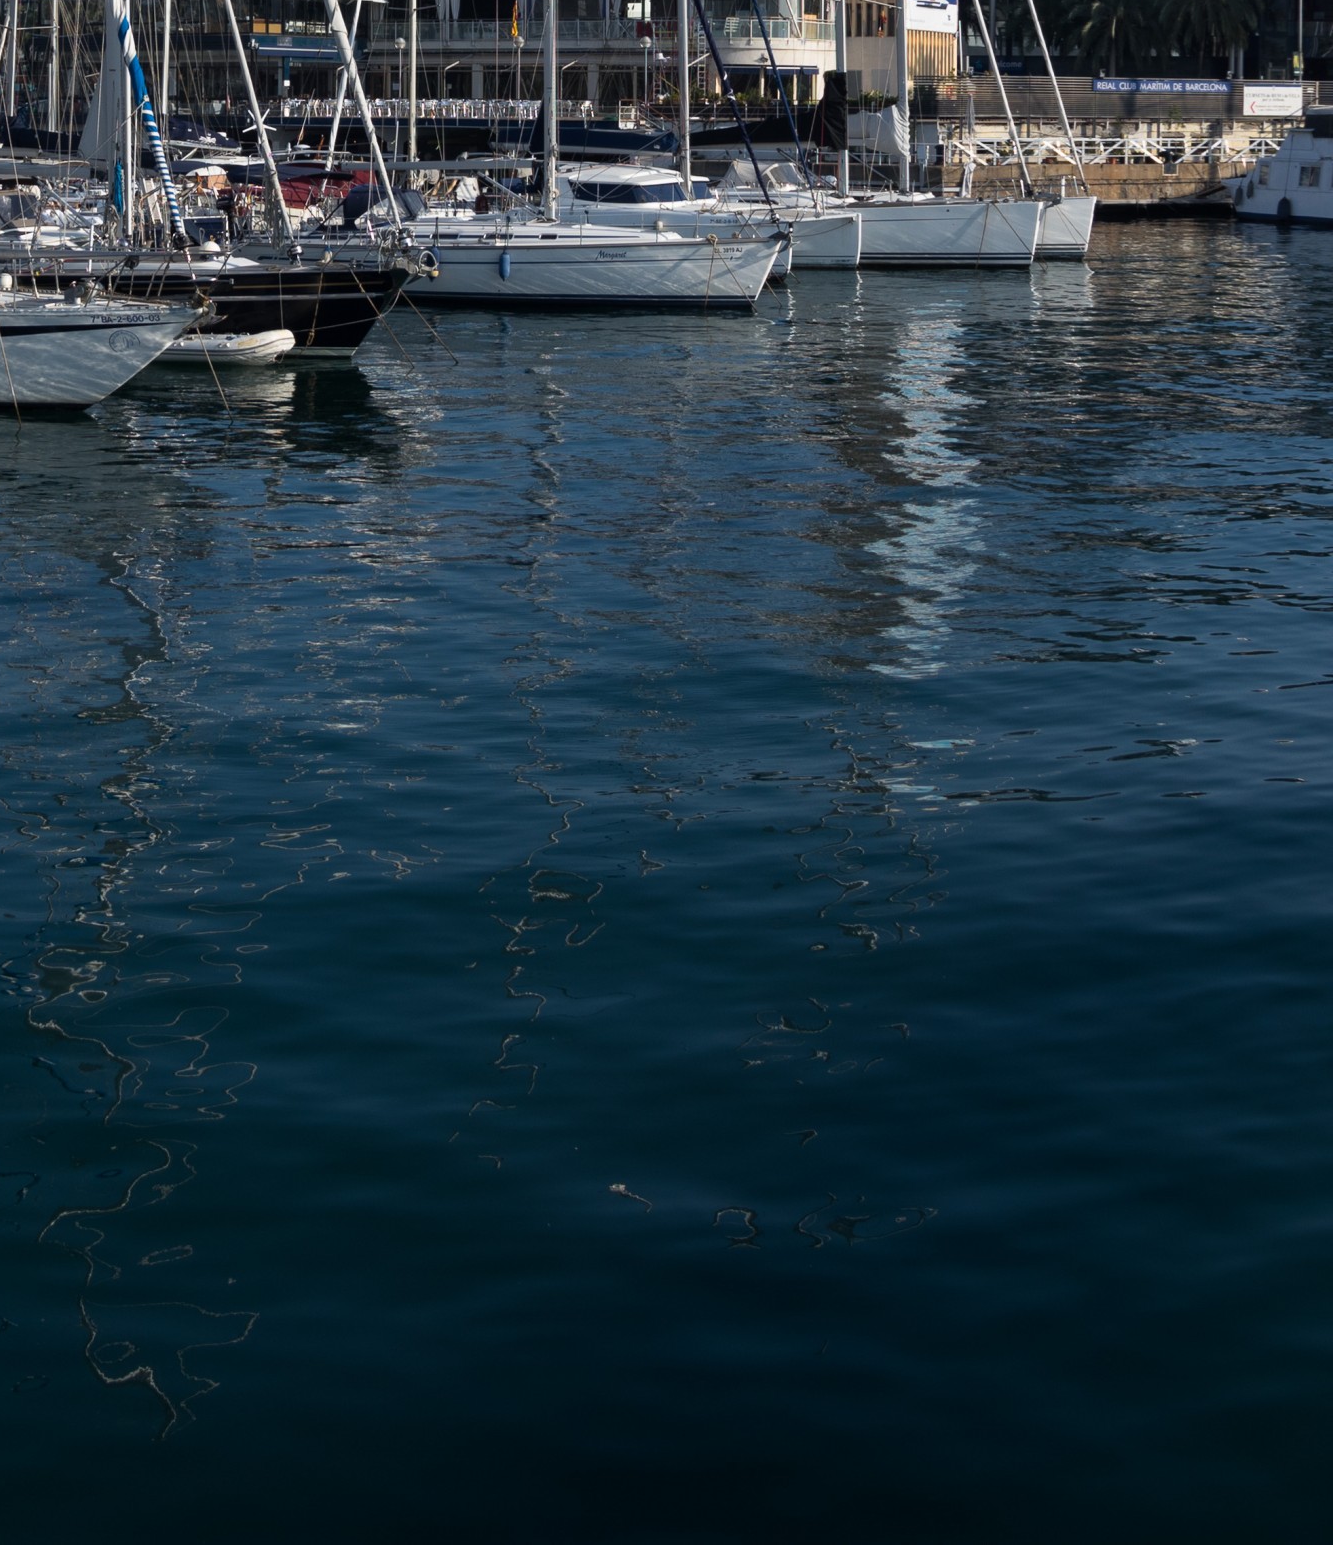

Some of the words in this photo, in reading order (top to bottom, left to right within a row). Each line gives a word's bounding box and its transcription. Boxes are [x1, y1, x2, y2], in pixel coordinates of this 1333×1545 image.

[1097, 81, 1116, 90] REIAL
[1119, 81, 1136, 91] CLUB
[1140, 80, 1171, 91] MARÍTIM
[1173, 82, 1183, 91] DE
[1185, 82, 1228, 92] BARCELONA
